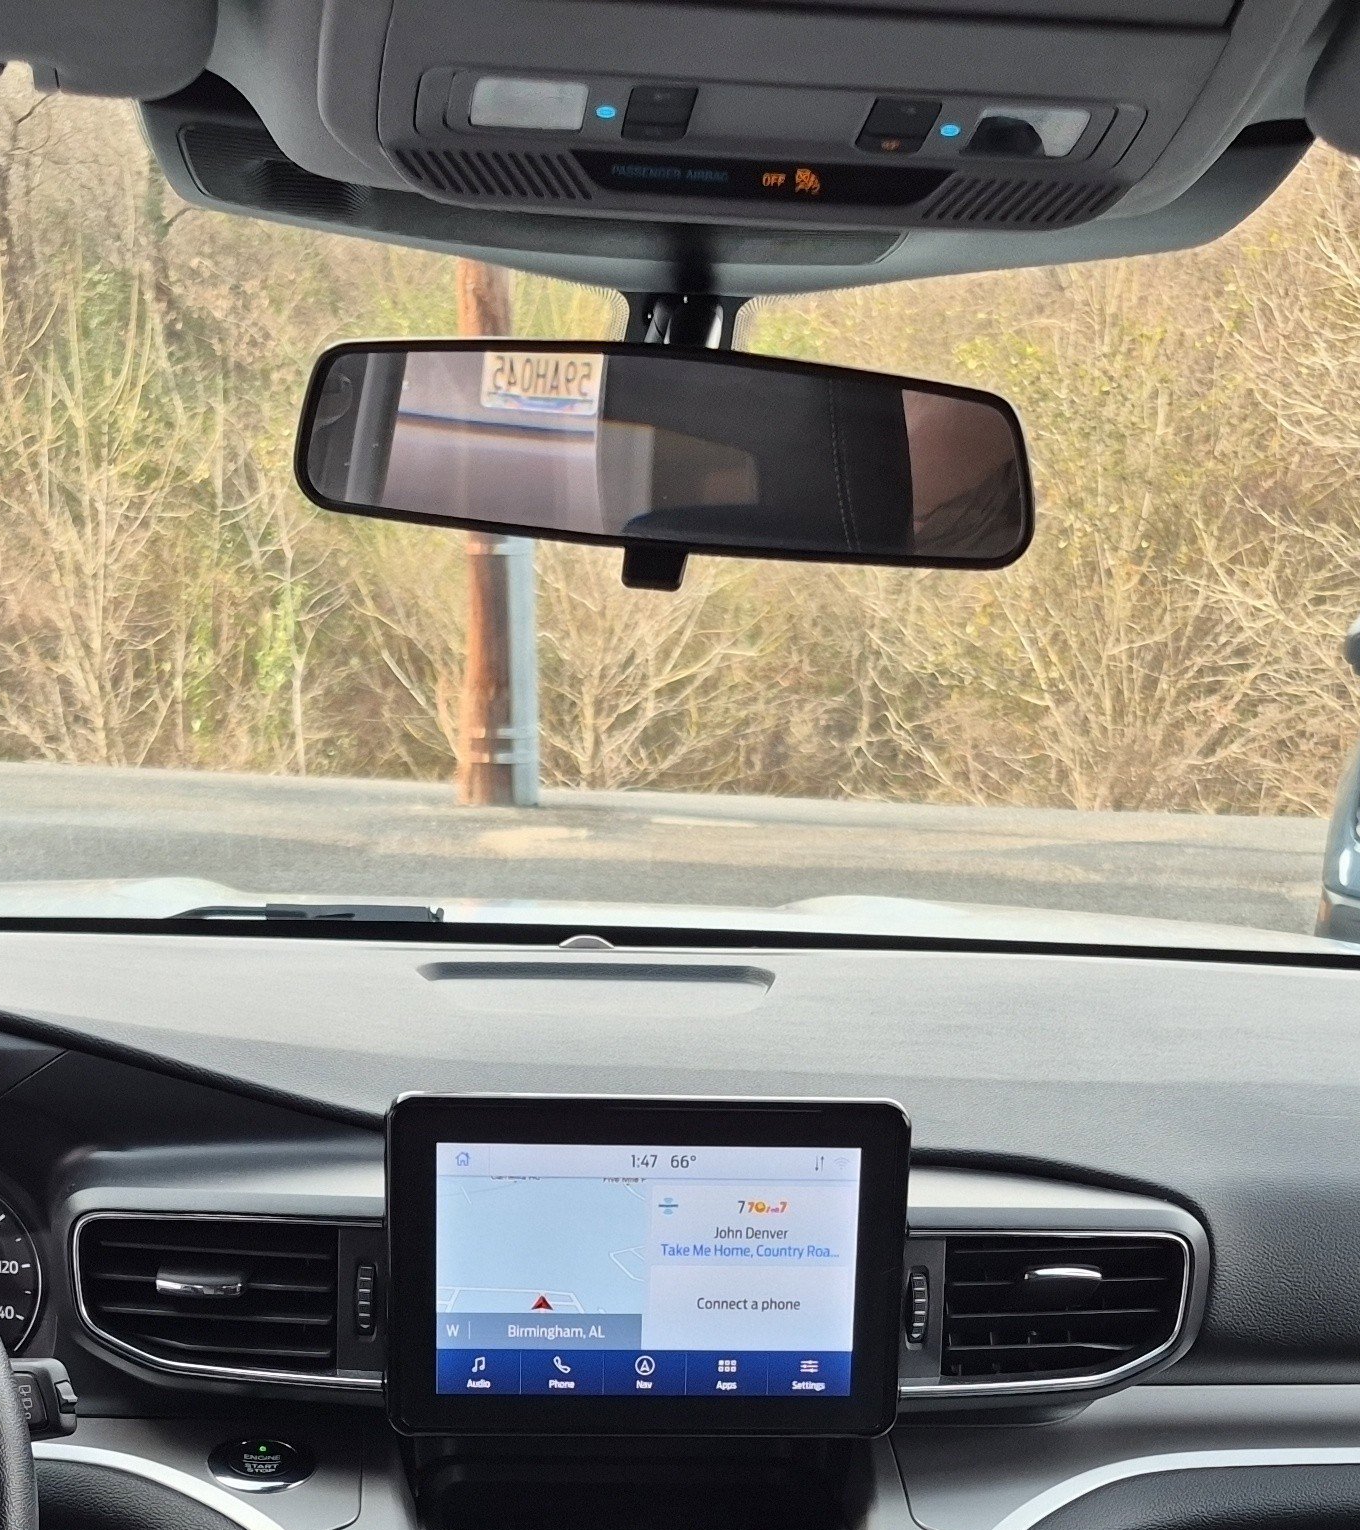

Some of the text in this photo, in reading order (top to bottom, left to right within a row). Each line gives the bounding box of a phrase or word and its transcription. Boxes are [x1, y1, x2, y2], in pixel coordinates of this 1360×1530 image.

[762, 173, 786, 187] OFF
[630, 1154, 697, 1169] 1:47 66°
[714, 1226, 788, 1240] John Denver
[661, 1244, 690, 1256] Take
[693, 1245, 711, 1257] Me
[714, 1245, 754, 1259] Home,
[756, 1245, 804, 1259] Country
[697, 1298, 801, 1312] Connect a phone
[446, 1324, 605, 1340] W Birmingham, AL
[467, 1378, 491, 1389] Audio
[549, 1379, 575, 1389] Phone
[636, 1380, 653, 1389] Nav
[716, 1381, 738, 1390] Apps
[792, 1381, 826, 1392] Settings
